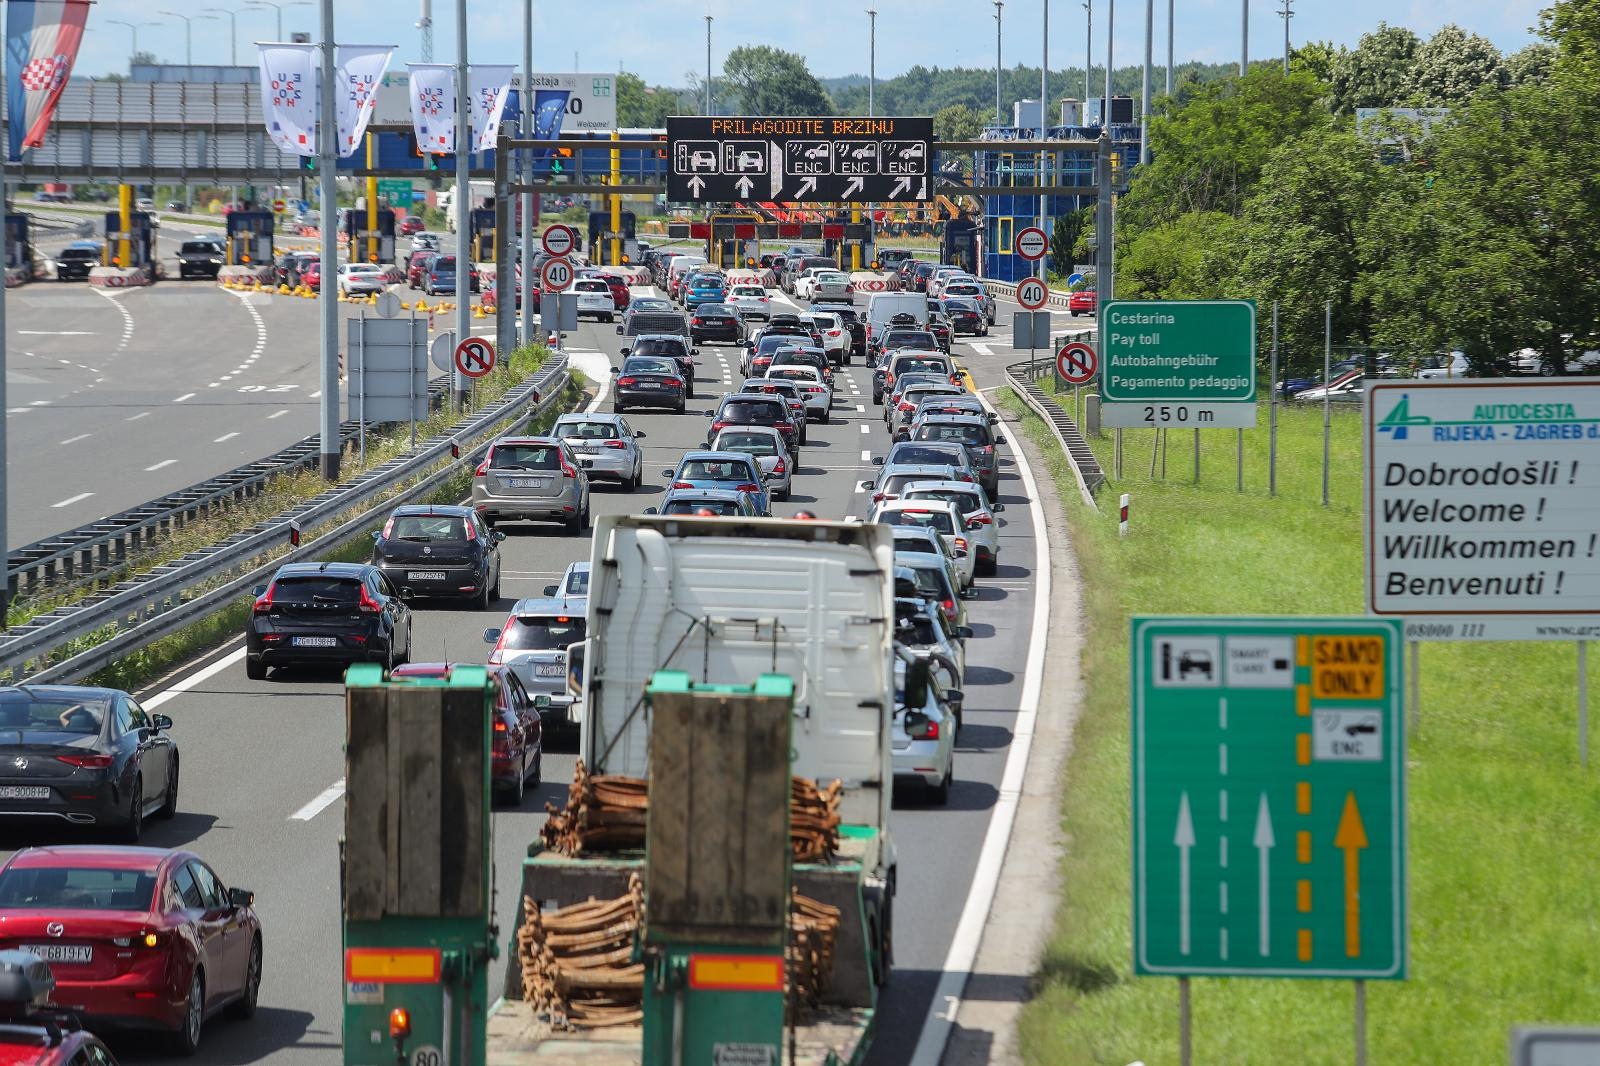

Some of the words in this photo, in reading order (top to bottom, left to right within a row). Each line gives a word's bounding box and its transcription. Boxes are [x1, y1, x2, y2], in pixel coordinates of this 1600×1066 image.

[712, 120, 824, 134] PRILAGODITE
[832, 120, 894, 134] BRZINU
[794, 162, 823, 173] ENC
[842, 162, 870, 173] ENC
[889, 162, 916, 173] ENC
[549, 267, 567, 282] 40
[1023, 286, 1041, 302] 40
[1111, 312, 1175, 324] Cestarina
[1111, 333, 1135, 348] Pay
[1139, 333, 1160, 345] toll
[1111, 354, 1219, 369] Autobahngebühr
[1111, 375, 1185, 390] Pagamento
[1189, 375, 1249, 390] pedaggio
[1198, 409, 1214, 422] m
[1473, 403, 1576, 420] AUTOCESTA
[1433, 425, 1495, 442] RIJEKA
[1514, 424, 1583, 440] ZAGREB
[1384, 461, 1559, 487] Dobrodošli
[1383, 498, 1525, 523] Welcome
[1384, 535, 1576, 560] Willkommen
[1385, 571, 1546, 596] Benvenuti
[1315, 639, 1380, 665] SAMO
[541, 666, 550, 675] ZG
[1320, 670, 1375, 695] ONLY
[1332, 740, 1363, 755] ENC
[416, 1051, 438, 1066] 80
